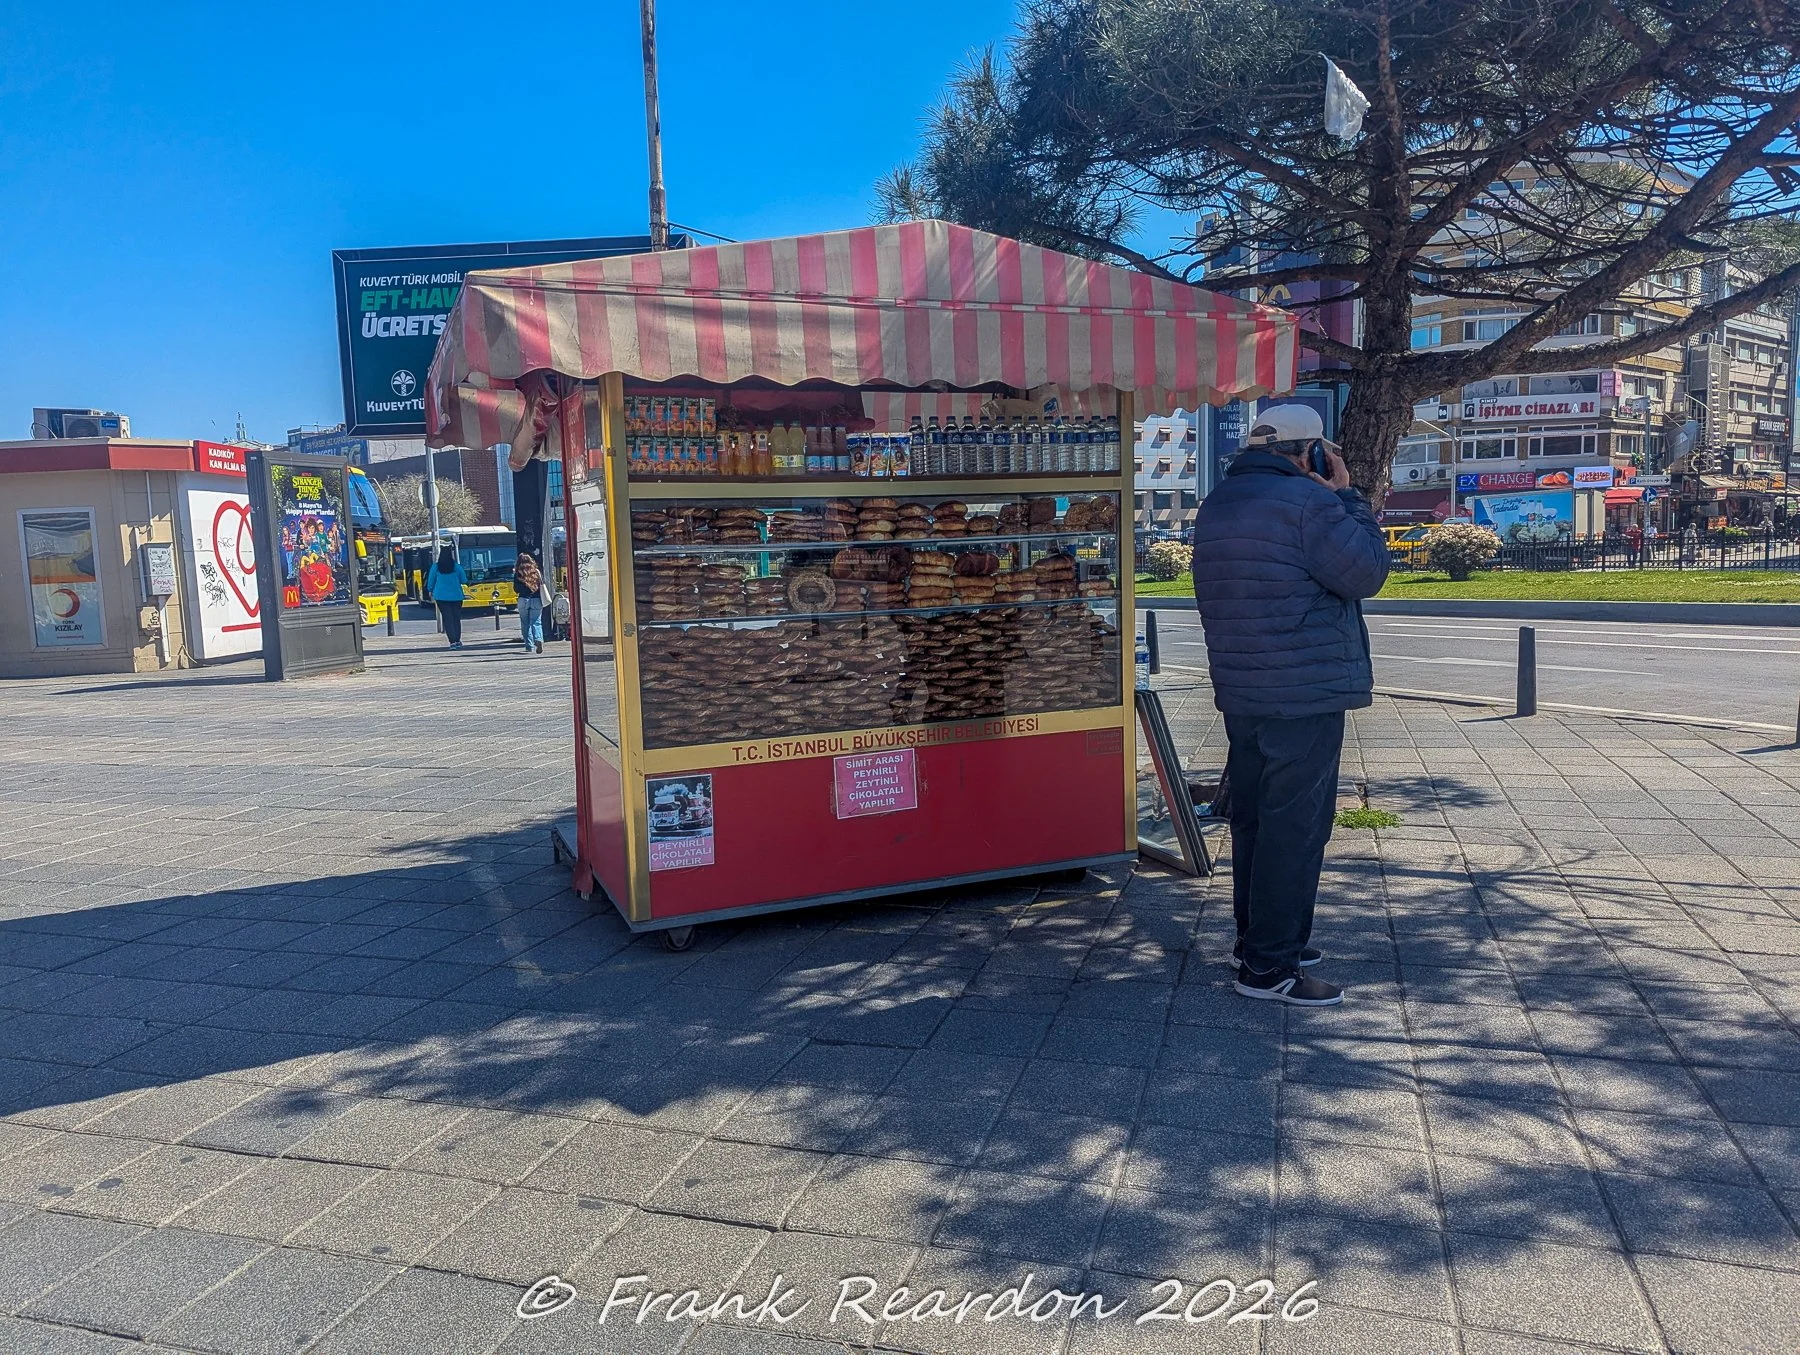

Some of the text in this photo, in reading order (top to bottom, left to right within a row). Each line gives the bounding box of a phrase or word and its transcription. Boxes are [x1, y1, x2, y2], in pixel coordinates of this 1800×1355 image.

[359, 270, 463, 288] KUVEYT TÜRK MOBİL
[361, 311, 451, 338] ÜCRETS
[1479, 401, 1595, 419] İŞİTME CİHAZLARI
[208, 447, 235, 460] KADIKÖY
[209, 459, 223, 470] KAN
[223, 461, 240, 471] ALMA
[292, 476, 324, 489] STRANGER
[1460, 472, 1533, 487] EX CHANGE
[298, 485, 319, 494] THINGS
[55, 624, 83, 632] KIZILAY
[732, 714, 1039, 761] T.C. İSTANBUL BÜYÜKŞEHİR BELEDİYESİ
[846, 755, 904, 769] SİMİT ARASI
[853, 764, 897, 778] PEYNİRLİ
[855, 775, 899, 789] ZEYTİNLİ
[849, 786, 904, 801] ÇİKOLATALI
[859, 797, 895, 809] YAPILIR
[651, 847, 712, 861] ÇİKOLATALI
[662, 857, 702, 867] YAPILIR
